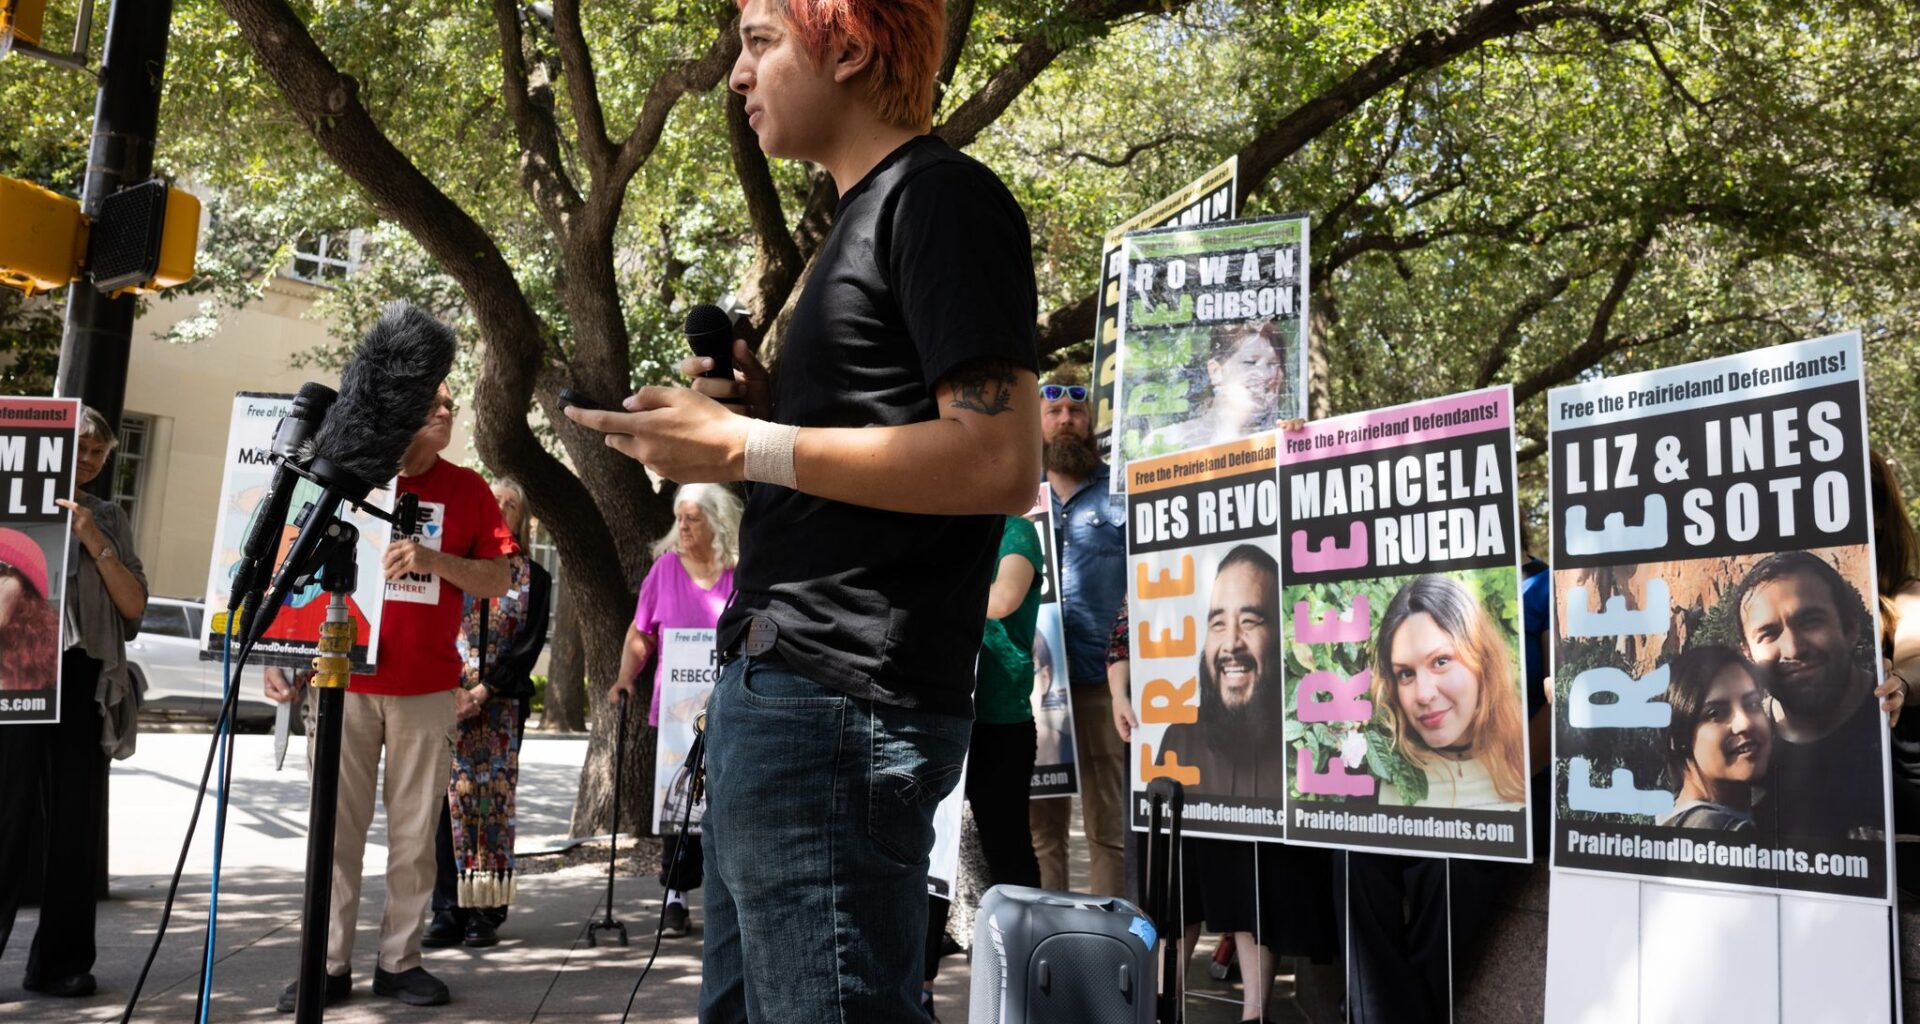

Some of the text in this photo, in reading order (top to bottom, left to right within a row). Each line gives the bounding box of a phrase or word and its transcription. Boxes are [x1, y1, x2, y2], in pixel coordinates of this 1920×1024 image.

[1135, 249, 1294, 292] ROWAN
[1196, 286, 1294, 321] GIBSON
[0, 407, 68, 421] fendants!
[247, 405, 265, 417] Free
[266, 406, 278, 418] all
[1560, 350, 1847, 420] Free the Prairieland Defendants!
[1287, 401, 1499, 454] Free the Prairieland Defendants!
[1566, 400, 1844, 495] LIZ & INES
[1135, 446, 1276, 486] Free the Prairieland Defendan
[1291, 443, 1503, 521] MARICELA
[1135, 479, 1277, 545] DES REVO
[1374, 503, 1506, 567] RUEDA
[1682, 470, 1850, 547] SOTO
[386, 583, 426, 594] TEHERE!
[1136, 553, 1201, 786] FREE
[1291, 520, 1376, 797] FREE
[1565, 493, 1675, 816] FREE
[1295, 808, 1515, 843] PrairielandDefendants.com
[1567, 830, 1869, 879] PrairielandDefendants.com
